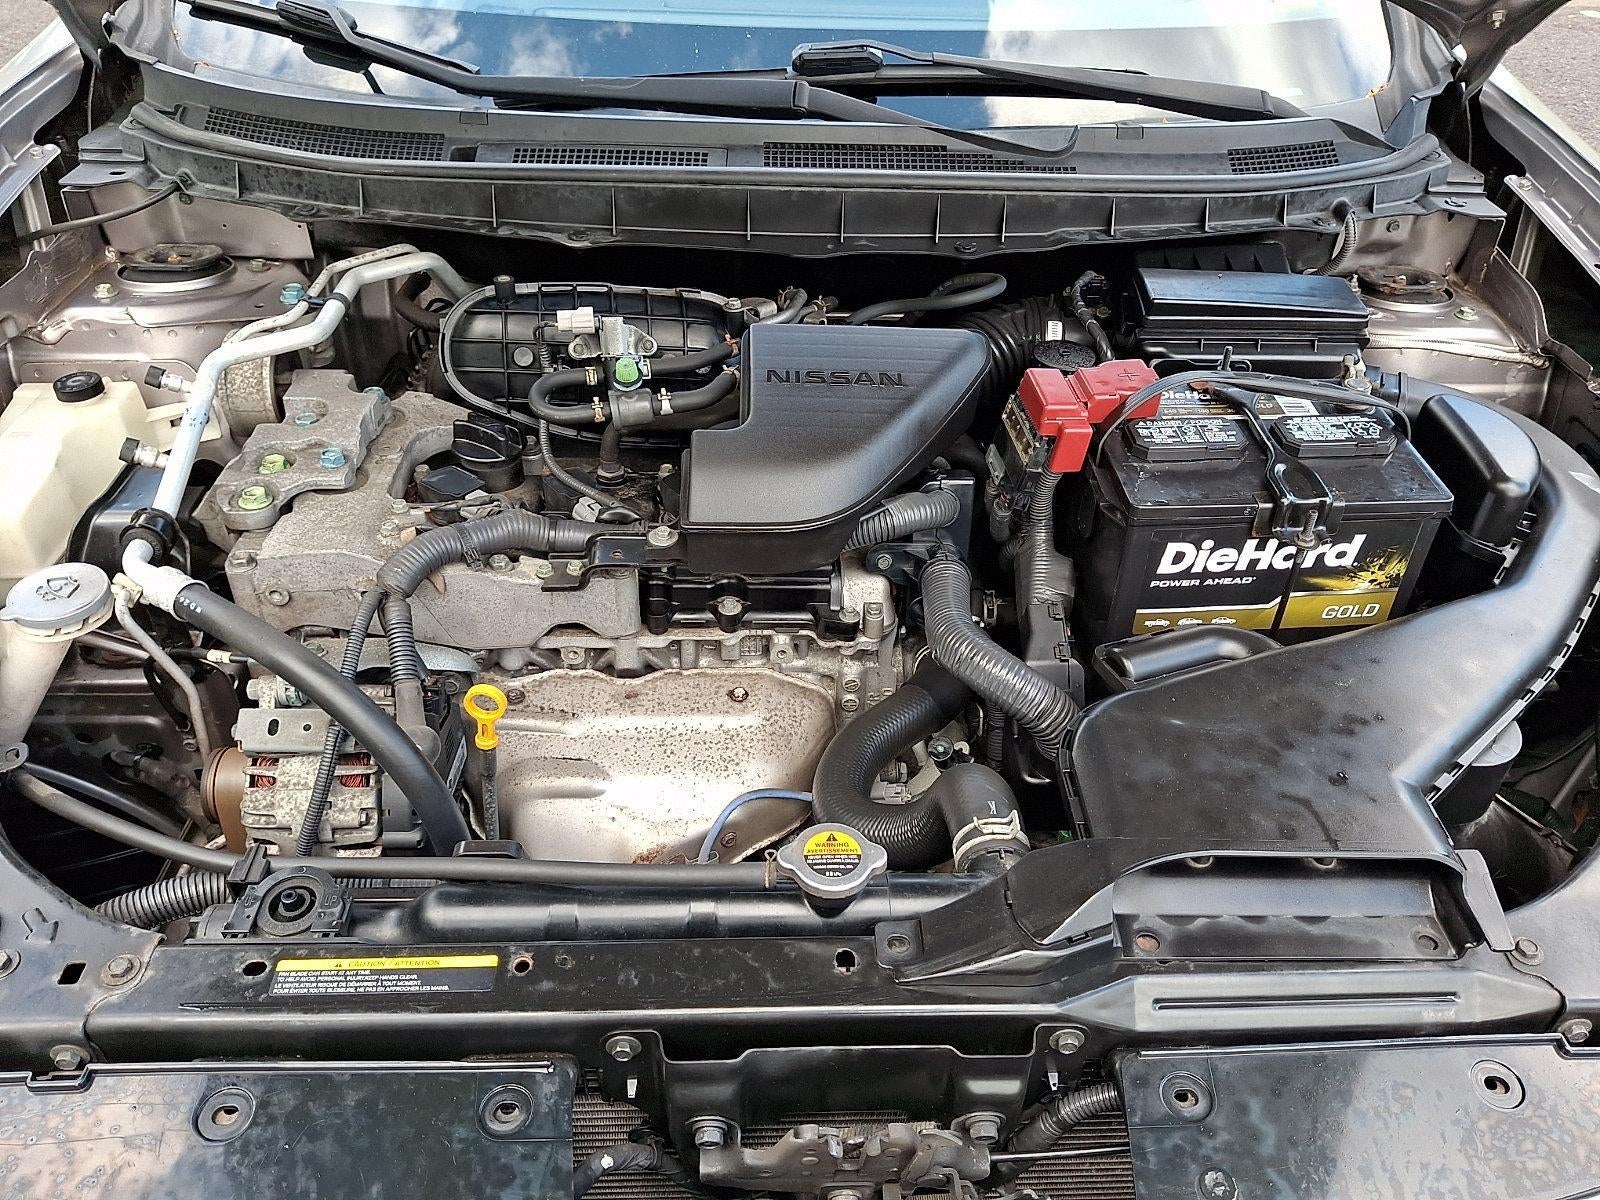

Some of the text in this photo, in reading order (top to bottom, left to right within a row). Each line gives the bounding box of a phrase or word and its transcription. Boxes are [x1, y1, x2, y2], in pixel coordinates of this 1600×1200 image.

[766, 369, 904, 388] NISSAN
[1150, 577, 1201, 588] POWER
[1321, 603, 1381, 619] GOLD
